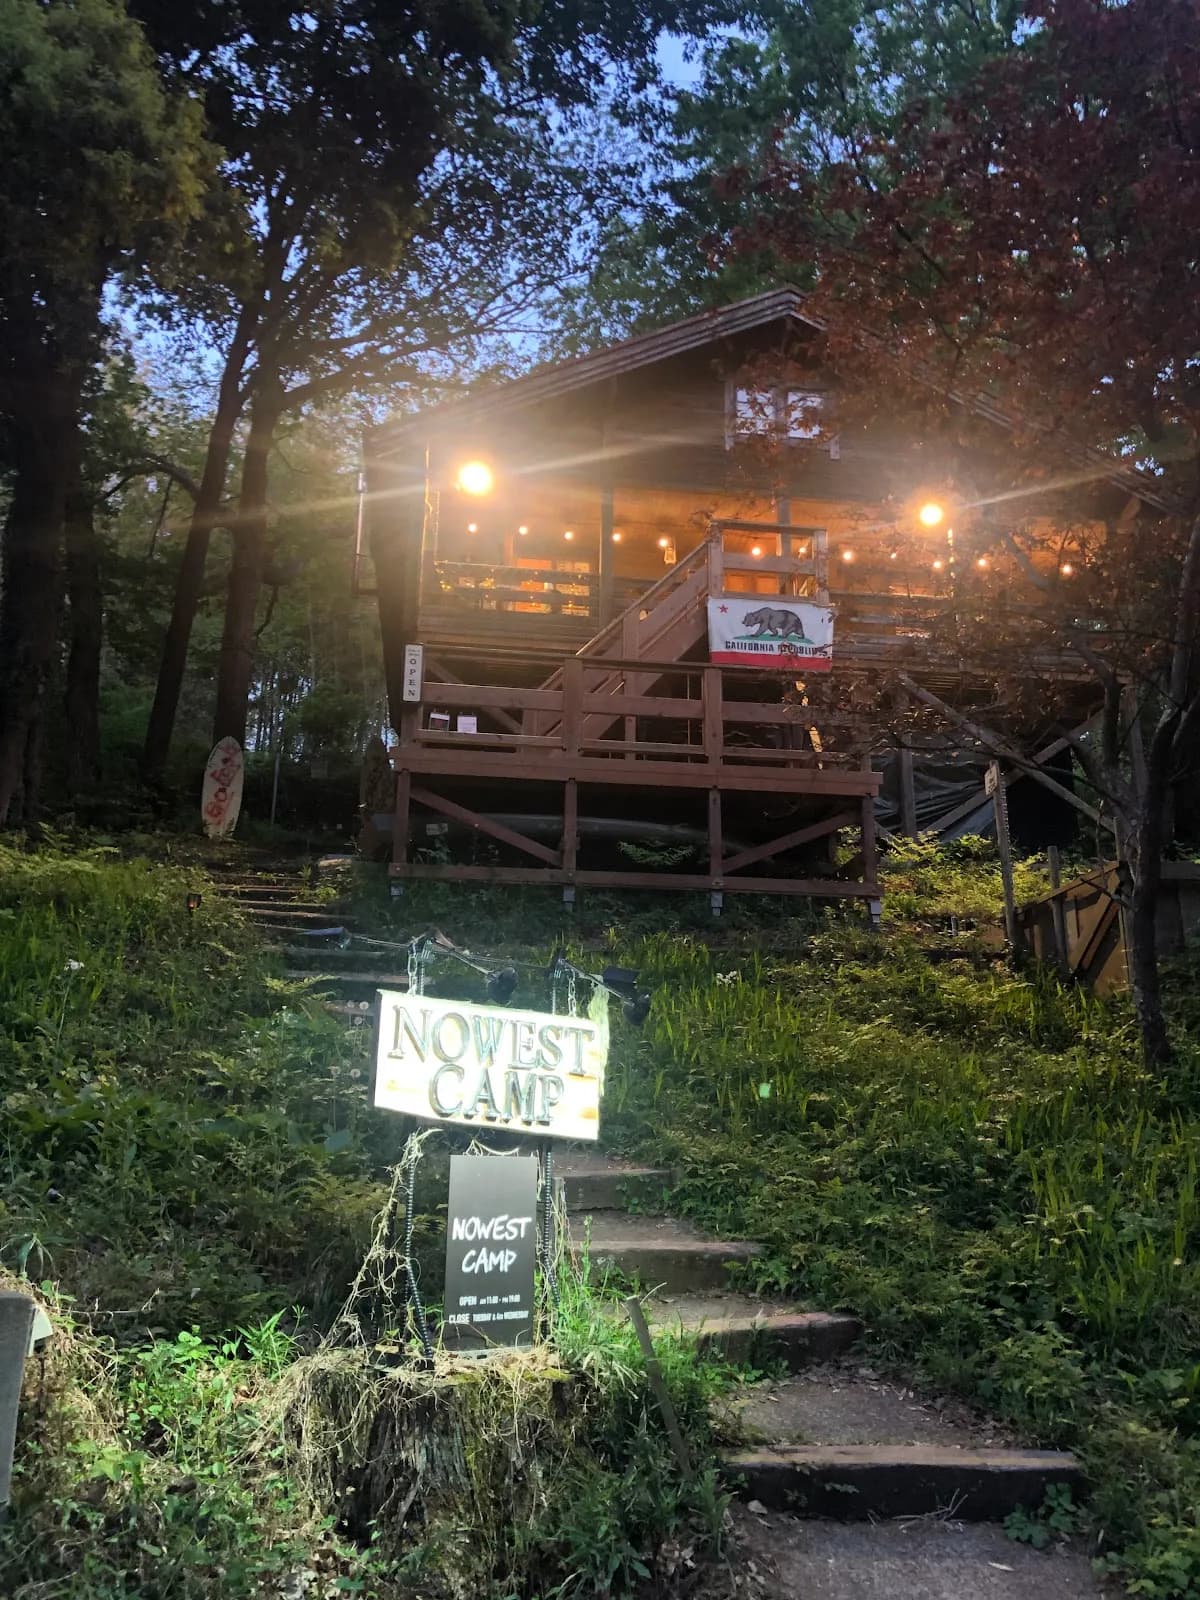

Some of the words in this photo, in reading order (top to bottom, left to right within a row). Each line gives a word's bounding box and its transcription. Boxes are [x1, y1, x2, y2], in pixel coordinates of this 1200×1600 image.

[725, 640, 775, 652] CALIFORNIA
[777, 644, 818, 656] RUBLIC
[408, 658, 417, 697] OPEN
[387, 1004, 594, 1076] NOWEST
[429, 1063, 565, 1126] CAMP
[452, 1214, 532, 1240] NOWEST
[461, 1247, 517, 1274] CAMP
[459, 1295, 477, 1306] OPEN
[448, 1312, 470, 1324] CLOSE
